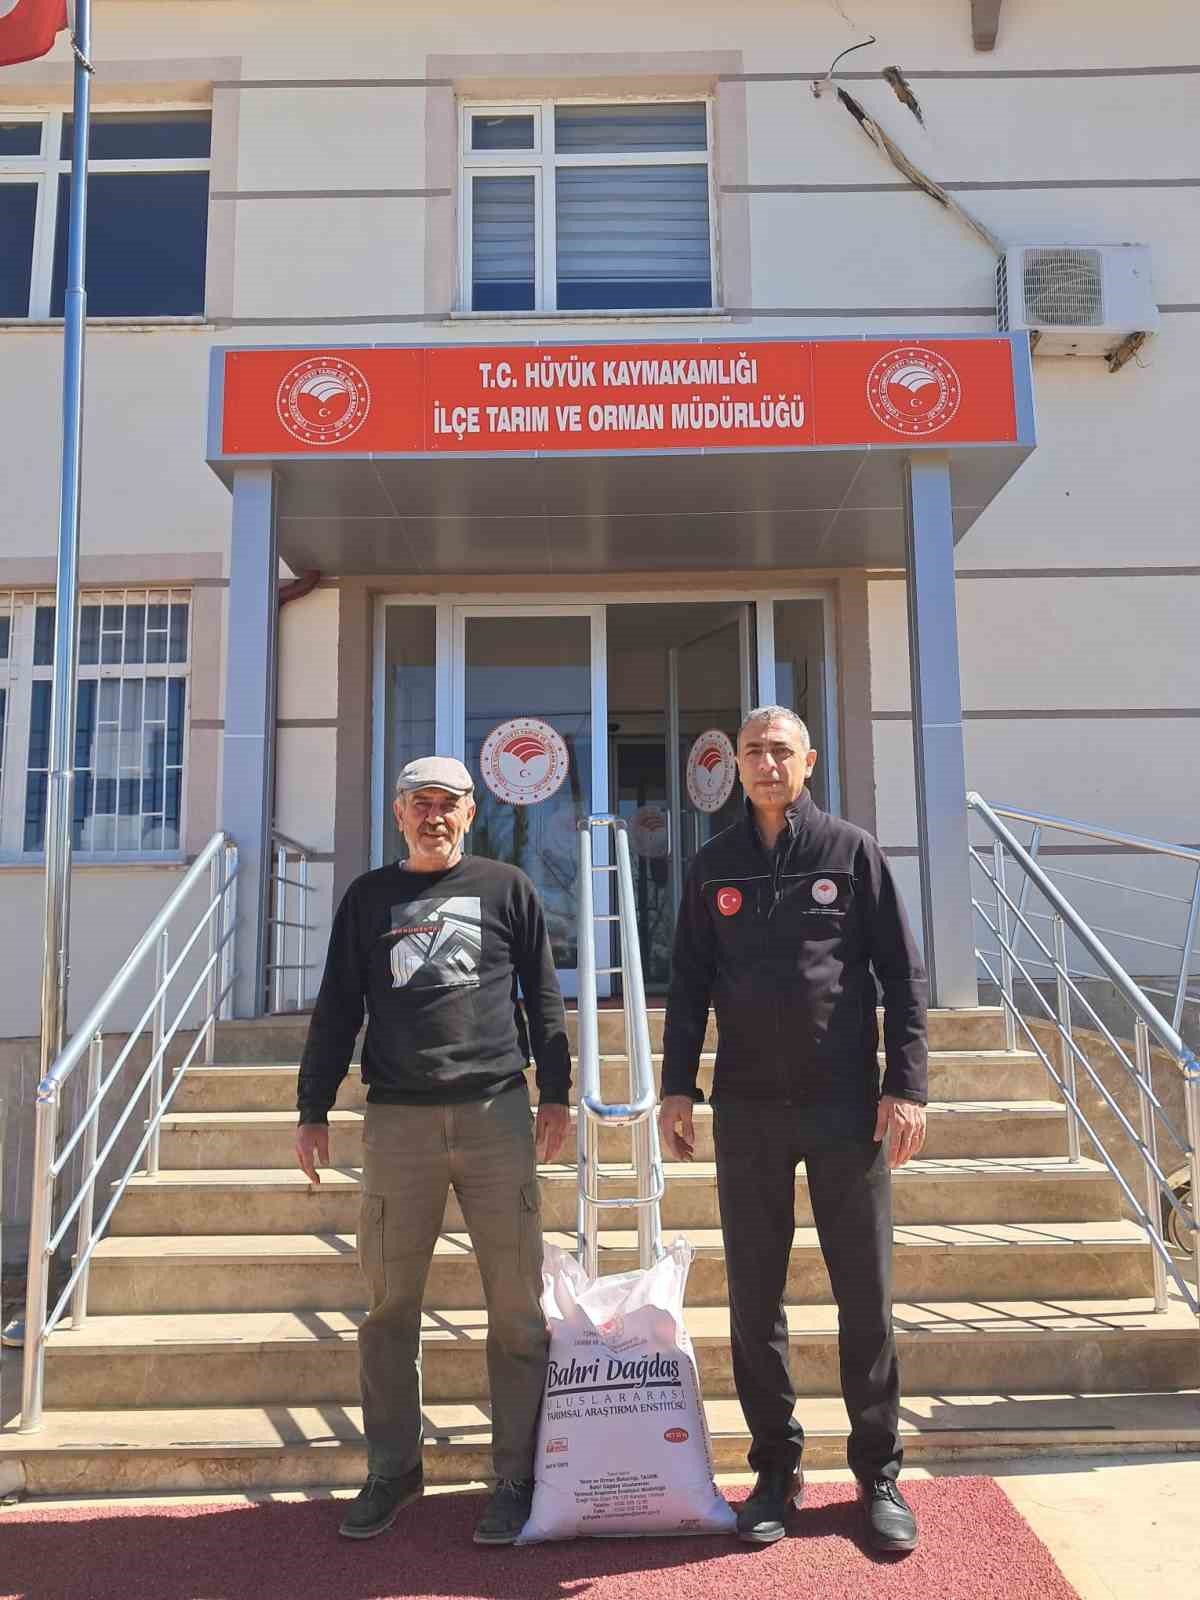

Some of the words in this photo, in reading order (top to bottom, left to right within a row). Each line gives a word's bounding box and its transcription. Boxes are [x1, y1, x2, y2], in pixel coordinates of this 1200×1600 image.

[479, 362, 517, 389] T.C.
[525, 355, 596, 388] HÜYÜK
[602, 351, 758, 387] KAYMAKAMLIĞI
[433, 400, 480, 441] İLÇE
[486, 406, 549, 433] TARIM
[555, 405, 582, 432] VE
[588, 404, 664, 431] ORMAN
[671, 394, 805, 430] MÜDÜRLÜĞÜ
[547, 1358, 600, 1388] Bahri
[607, 1352, 680, 1388] Dağdaş
